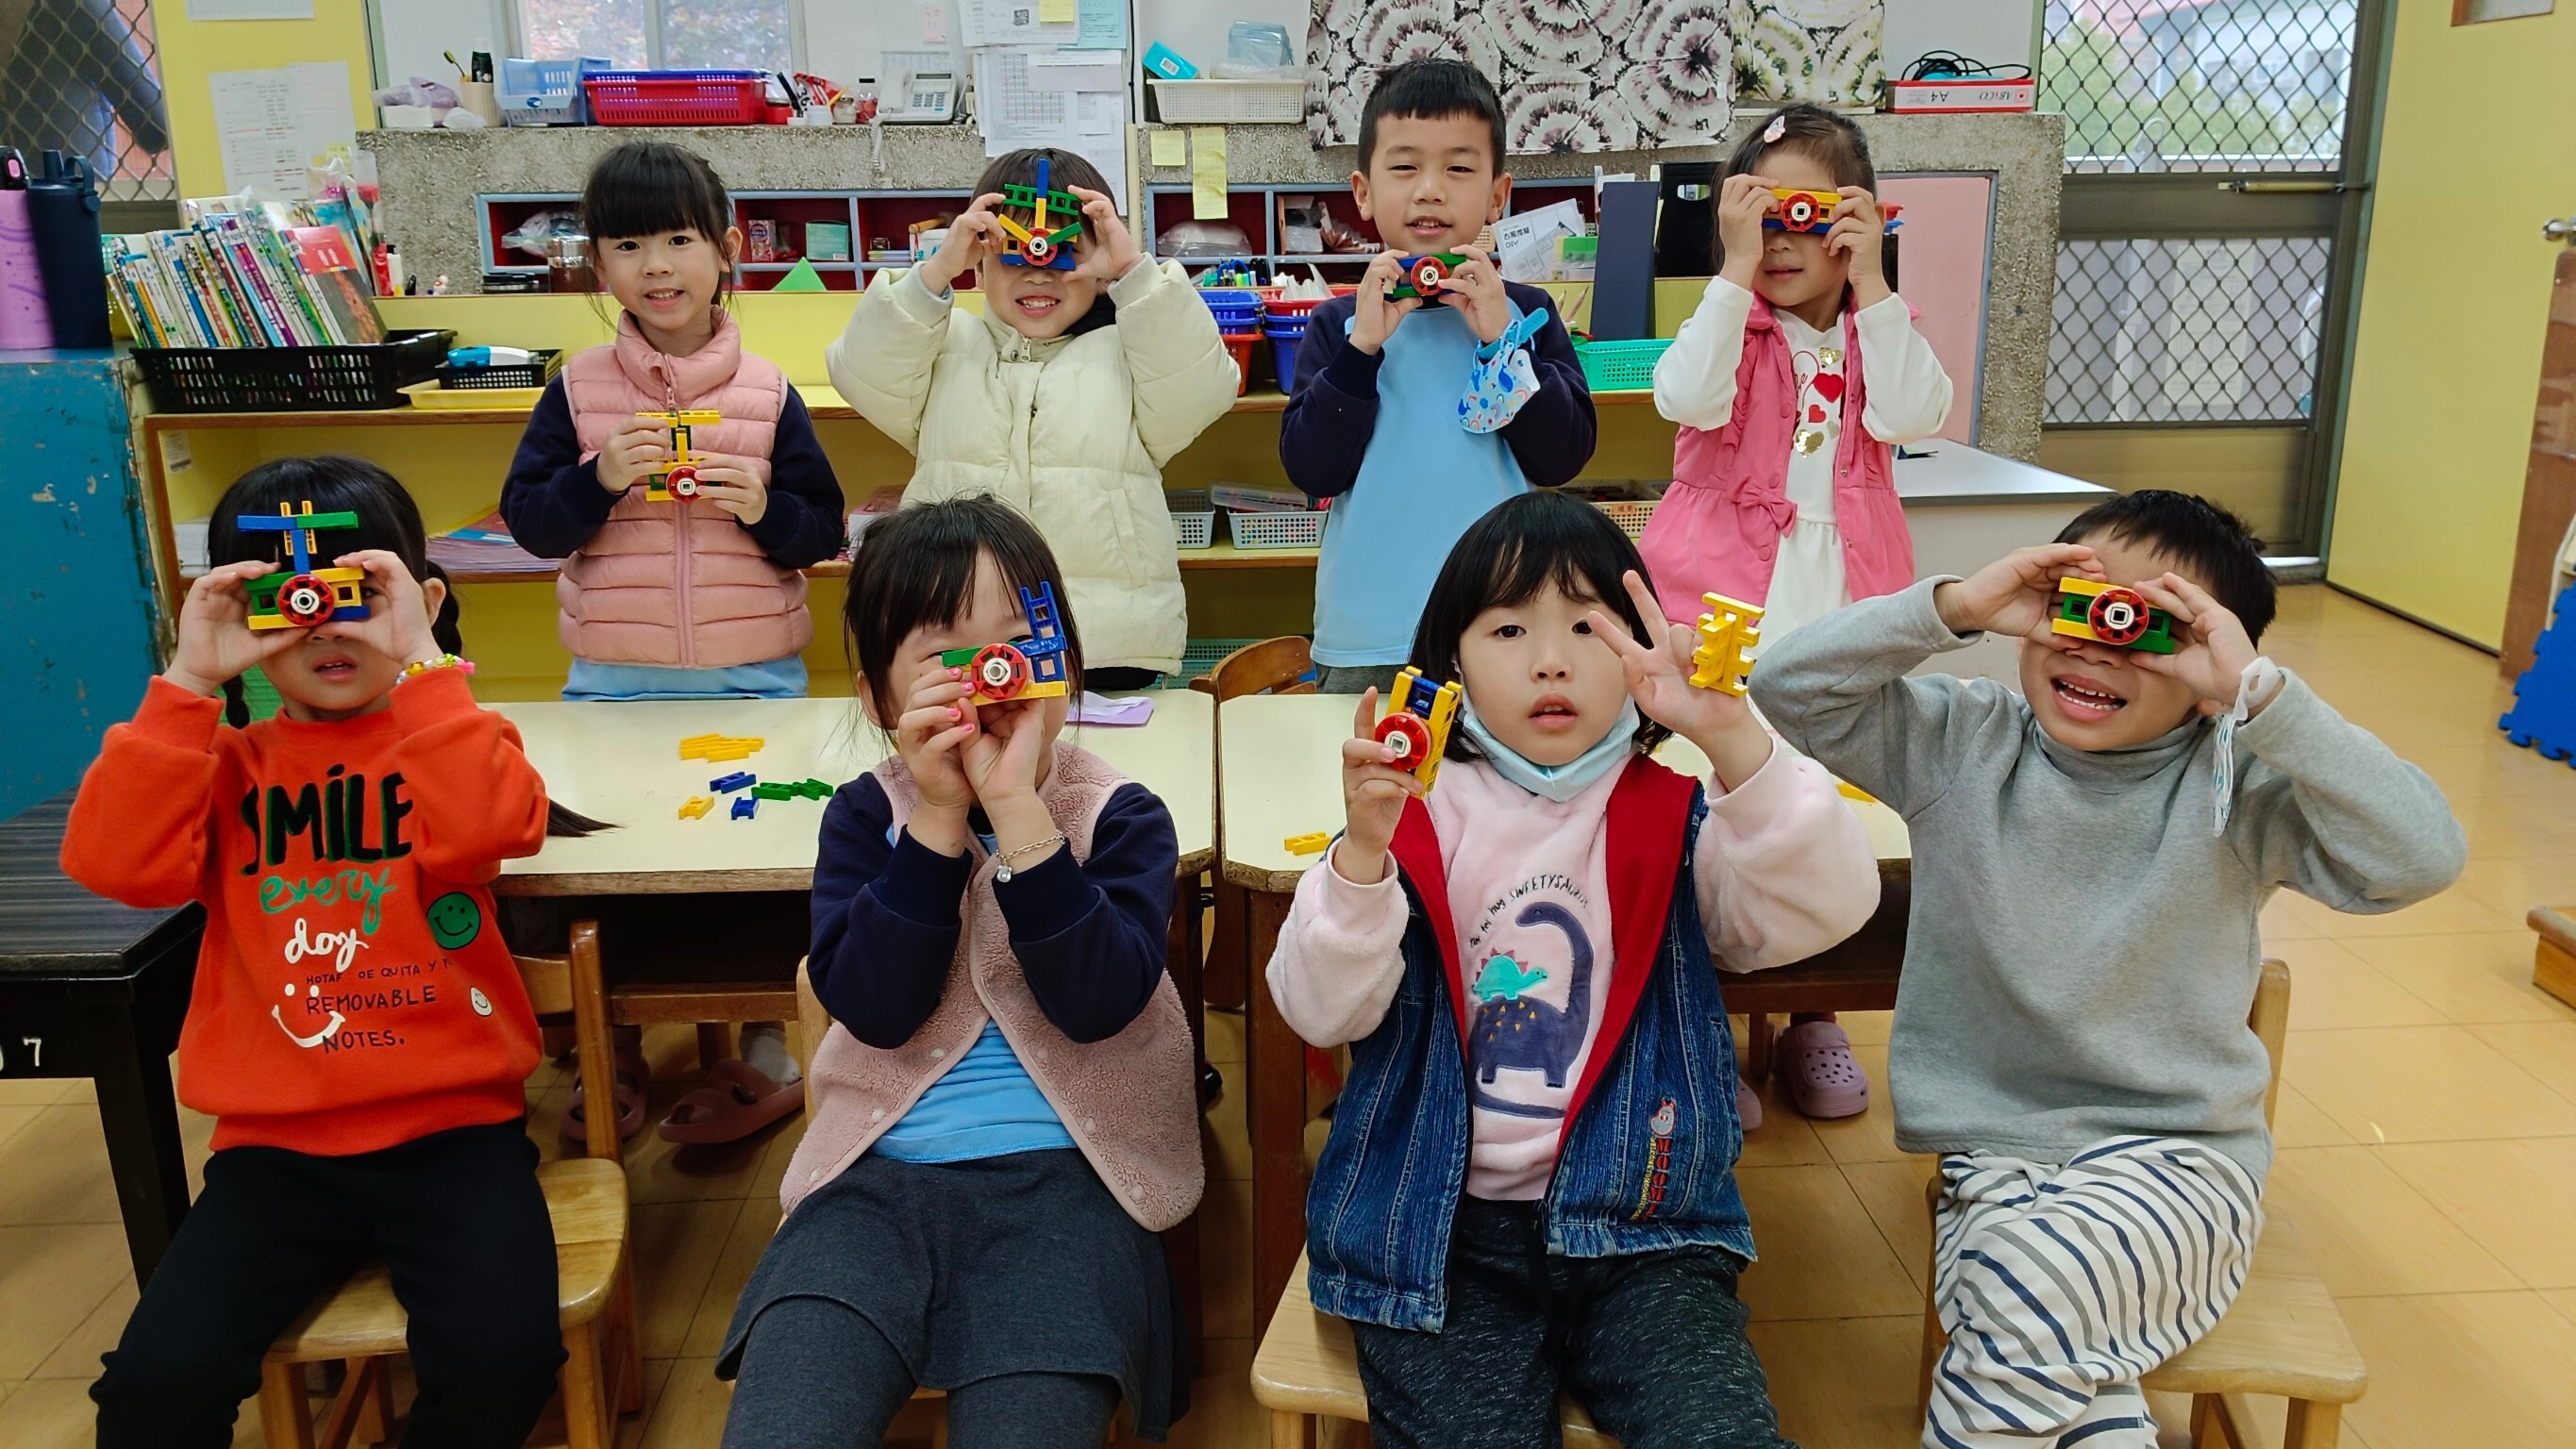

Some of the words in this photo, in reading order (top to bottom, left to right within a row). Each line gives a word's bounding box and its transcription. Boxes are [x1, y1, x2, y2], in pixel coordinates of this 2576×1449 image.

[1931, 91, 1950, 103] A4
[259, 867, 396, 936] every
[285, 918, 369, 973] day
[380, 964, 421, 977] QUITA
[306, 985, 437, 1015] REMOVABLE
